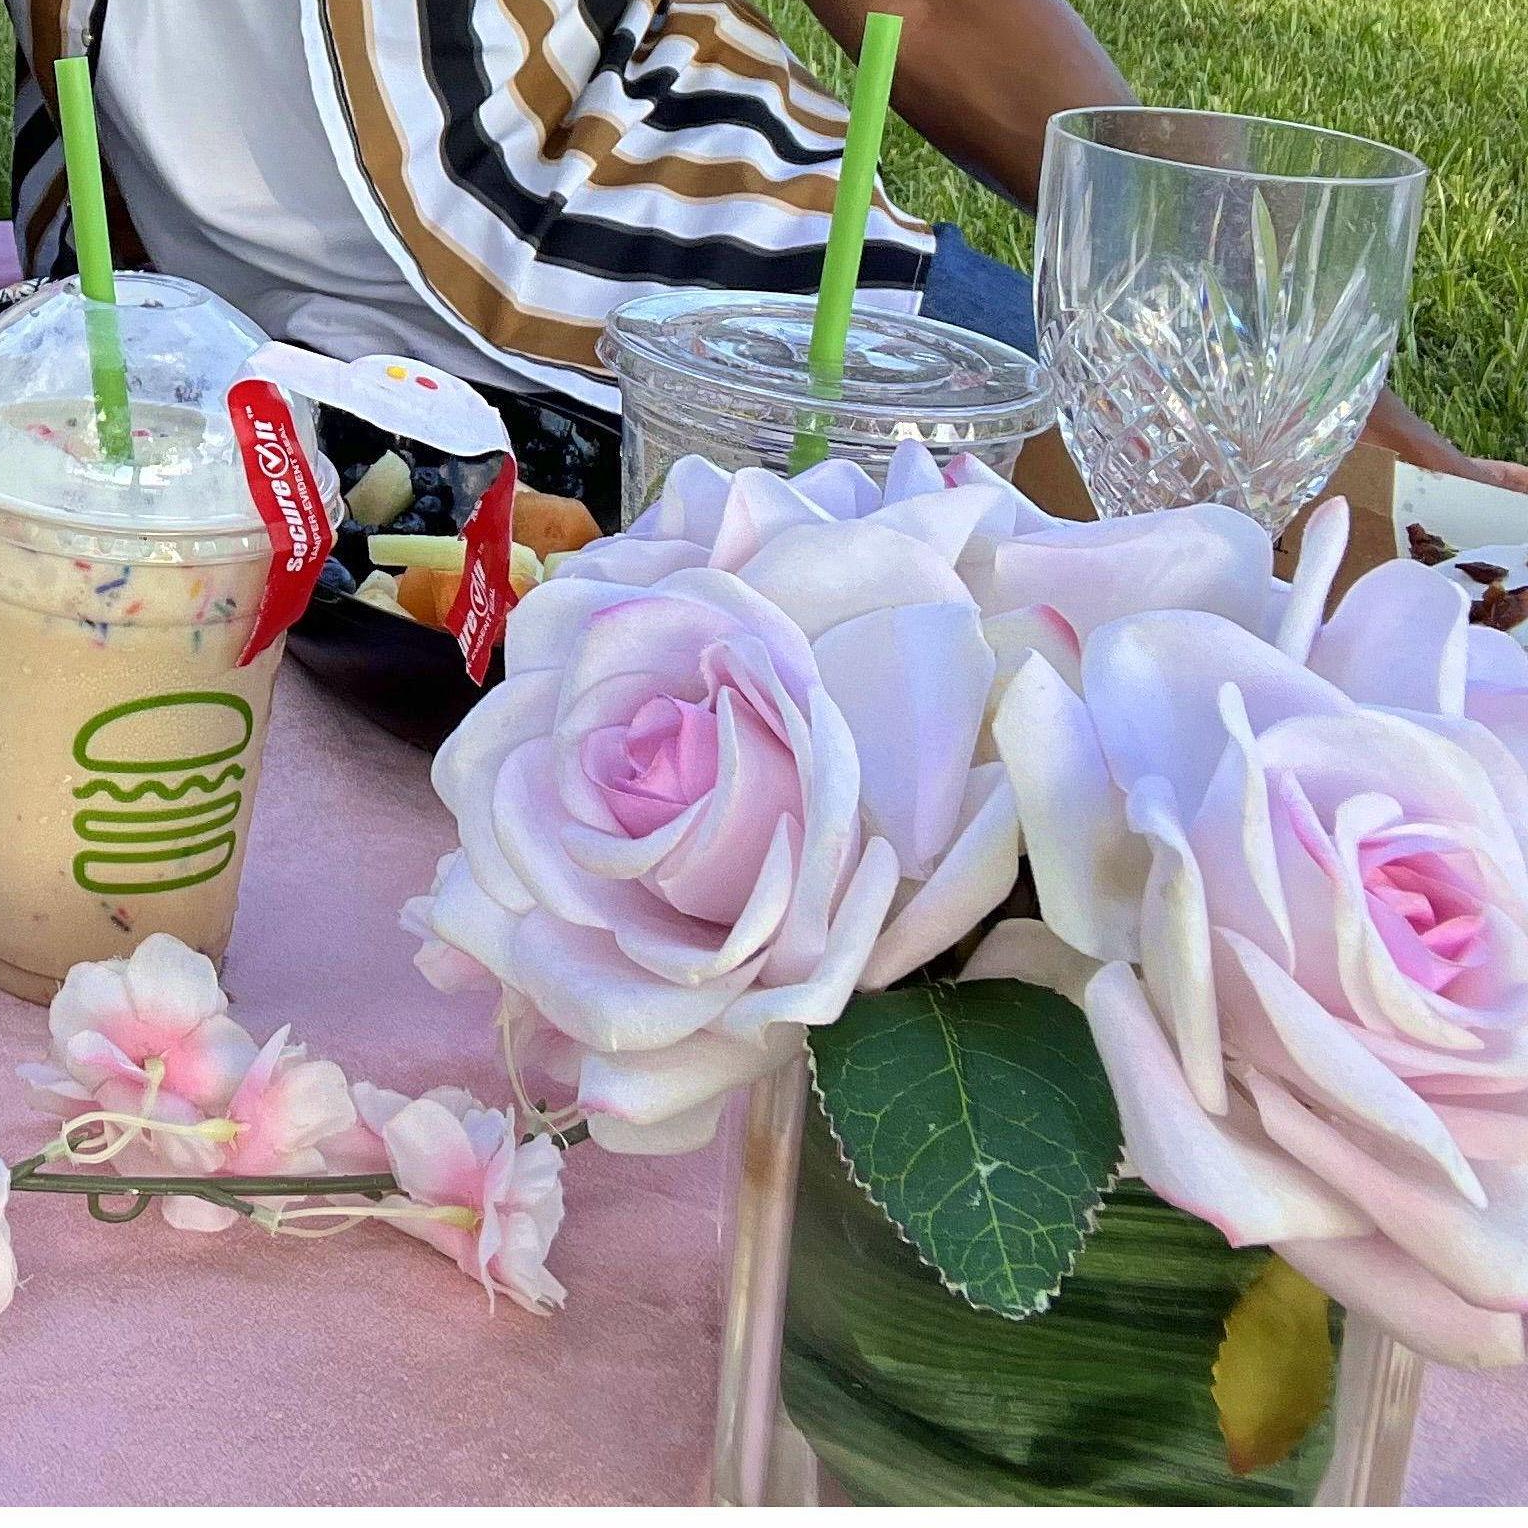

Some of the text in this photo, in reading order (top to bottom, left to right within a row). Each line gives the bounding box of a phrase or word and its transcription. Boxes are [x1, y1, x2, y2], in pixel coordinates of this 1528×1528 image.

[271, 479, 308, 572] Secure
[277, 422, 322, 563] TAMPER-EVIDENT SEAL
